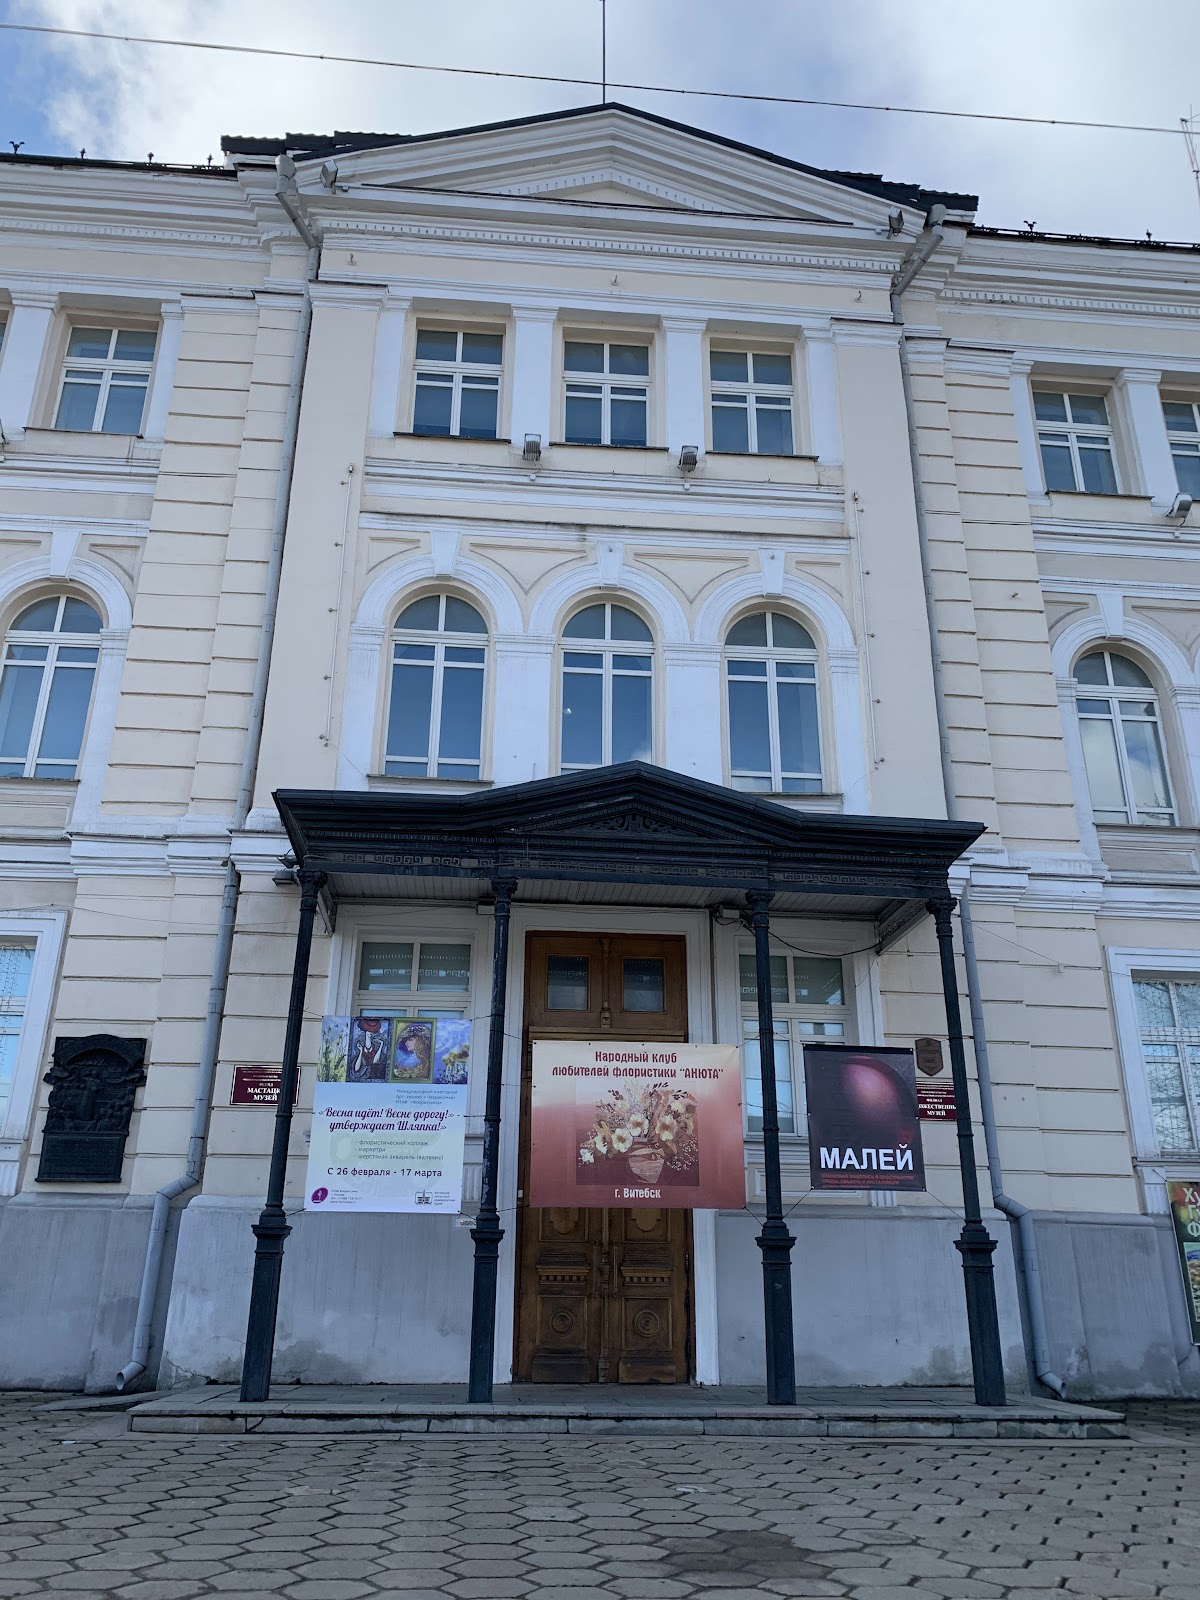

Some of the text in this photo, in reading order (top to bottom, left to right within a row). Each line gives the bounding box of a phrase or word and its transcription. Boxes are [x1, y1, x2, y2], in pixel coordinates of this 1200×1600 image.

[595, 1051, 677, 1064] Народный клуб
[552, 1065, 609, 1077] любителей
[612, 1067, 676, 1078] флористики
[318, 1107, 353, 1118] «Весна
[355, 1108, 384, 1120] идёт!
[385, 1108, 412, 1118] Весне
[414, 1110, 454, 1121] дорогу!»
[329, 1120, 446, 1132] утверждает Шляпка!»
[820, 1144, 914, 1170] МАЛЕЙ
[328, 1168, 334, 1176] С
[336, 1168, 348, 1176] 26
[351, 1168, 390, 1178] февраля
[414, 1170, 442, 1178] марта
[614, 1188, 661, 1198] г. Витебск
